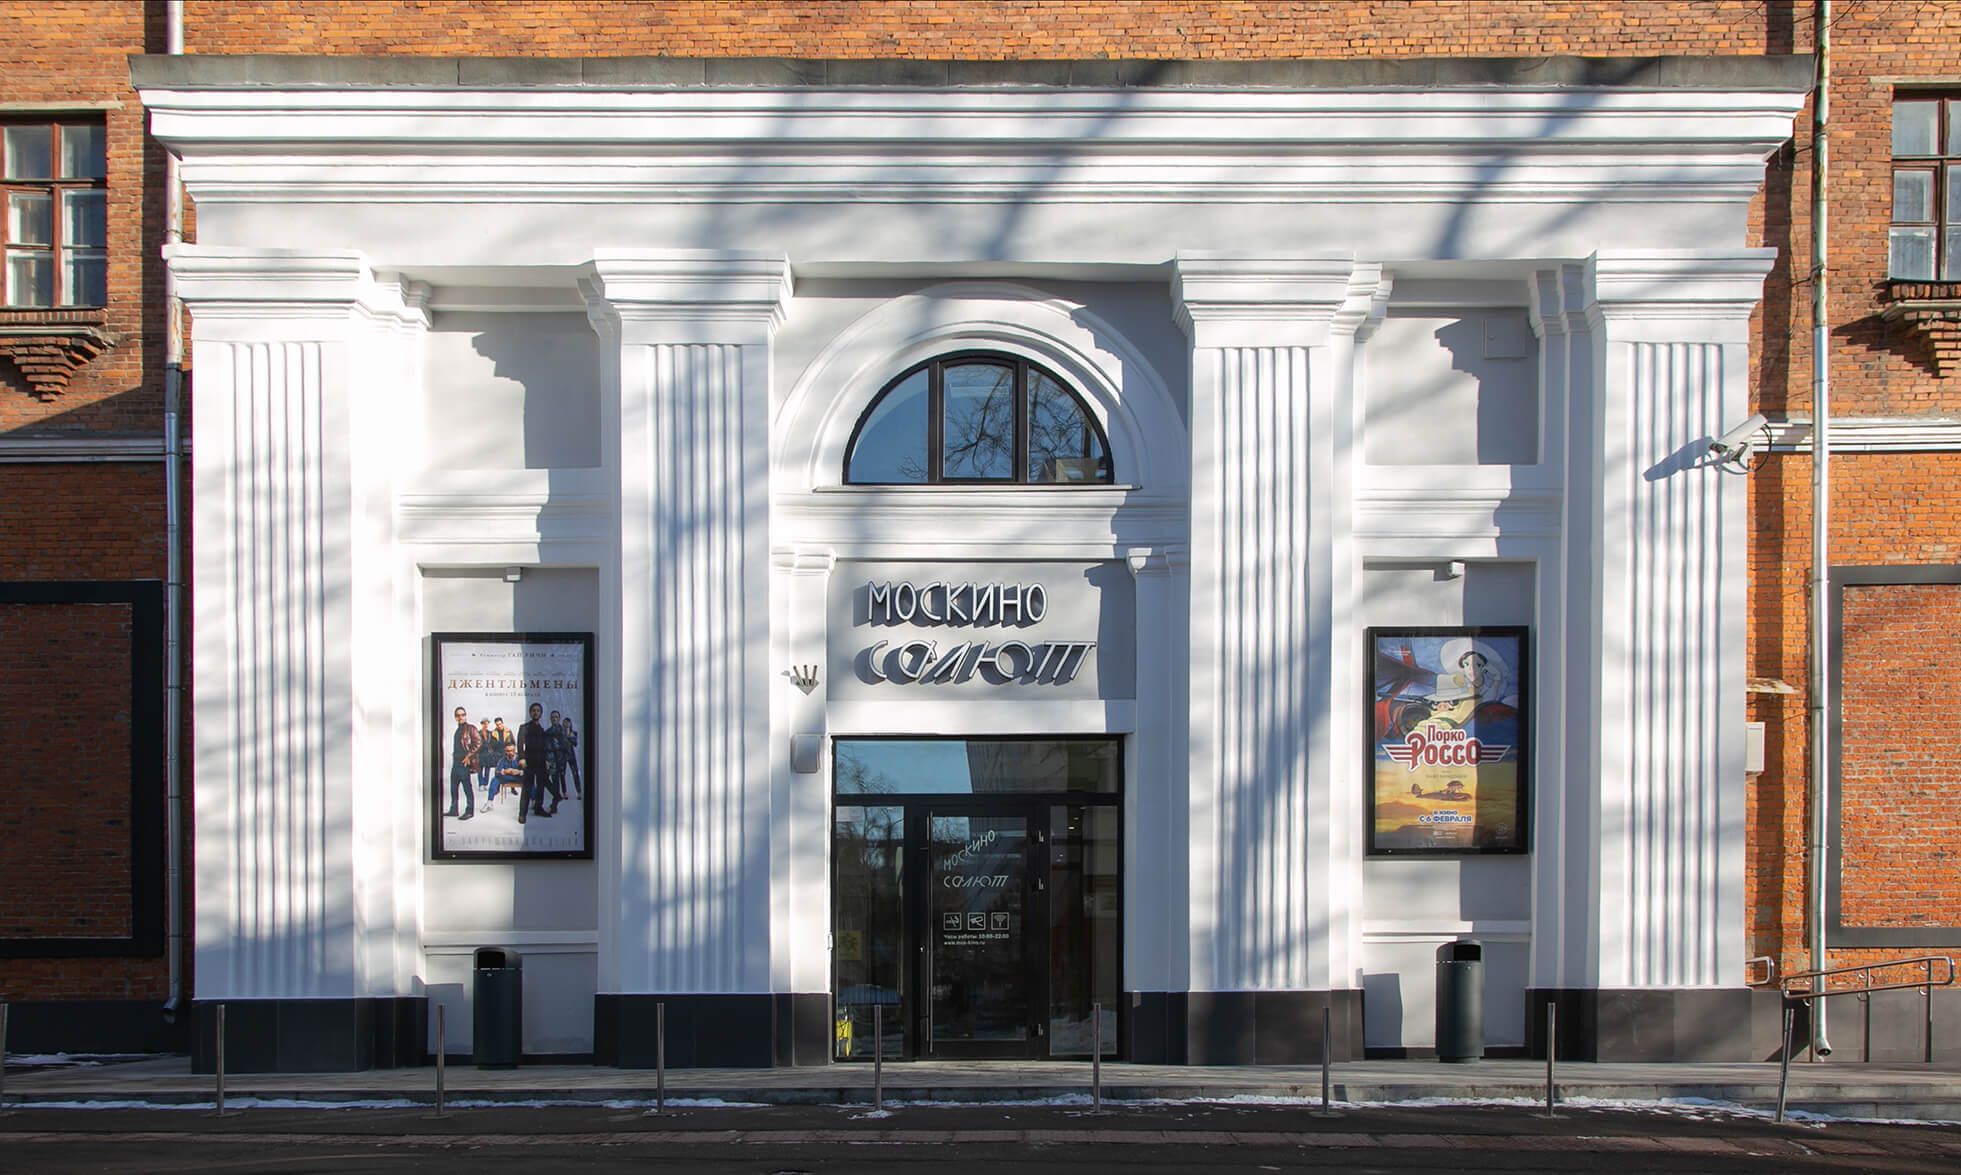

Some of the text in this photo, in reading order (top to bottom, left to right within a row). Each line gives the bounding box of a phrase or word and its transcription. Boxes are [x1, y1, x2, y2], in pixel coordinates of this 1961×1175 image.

[868, 581, 1048, 621] МОСКИНО
[448, 679, 578, 690] ДЖЕНТЛЬМЕНЫ
[1427, 725, 1465, 743] Порко
[944, 830, 995, 871] МОСКИНО
